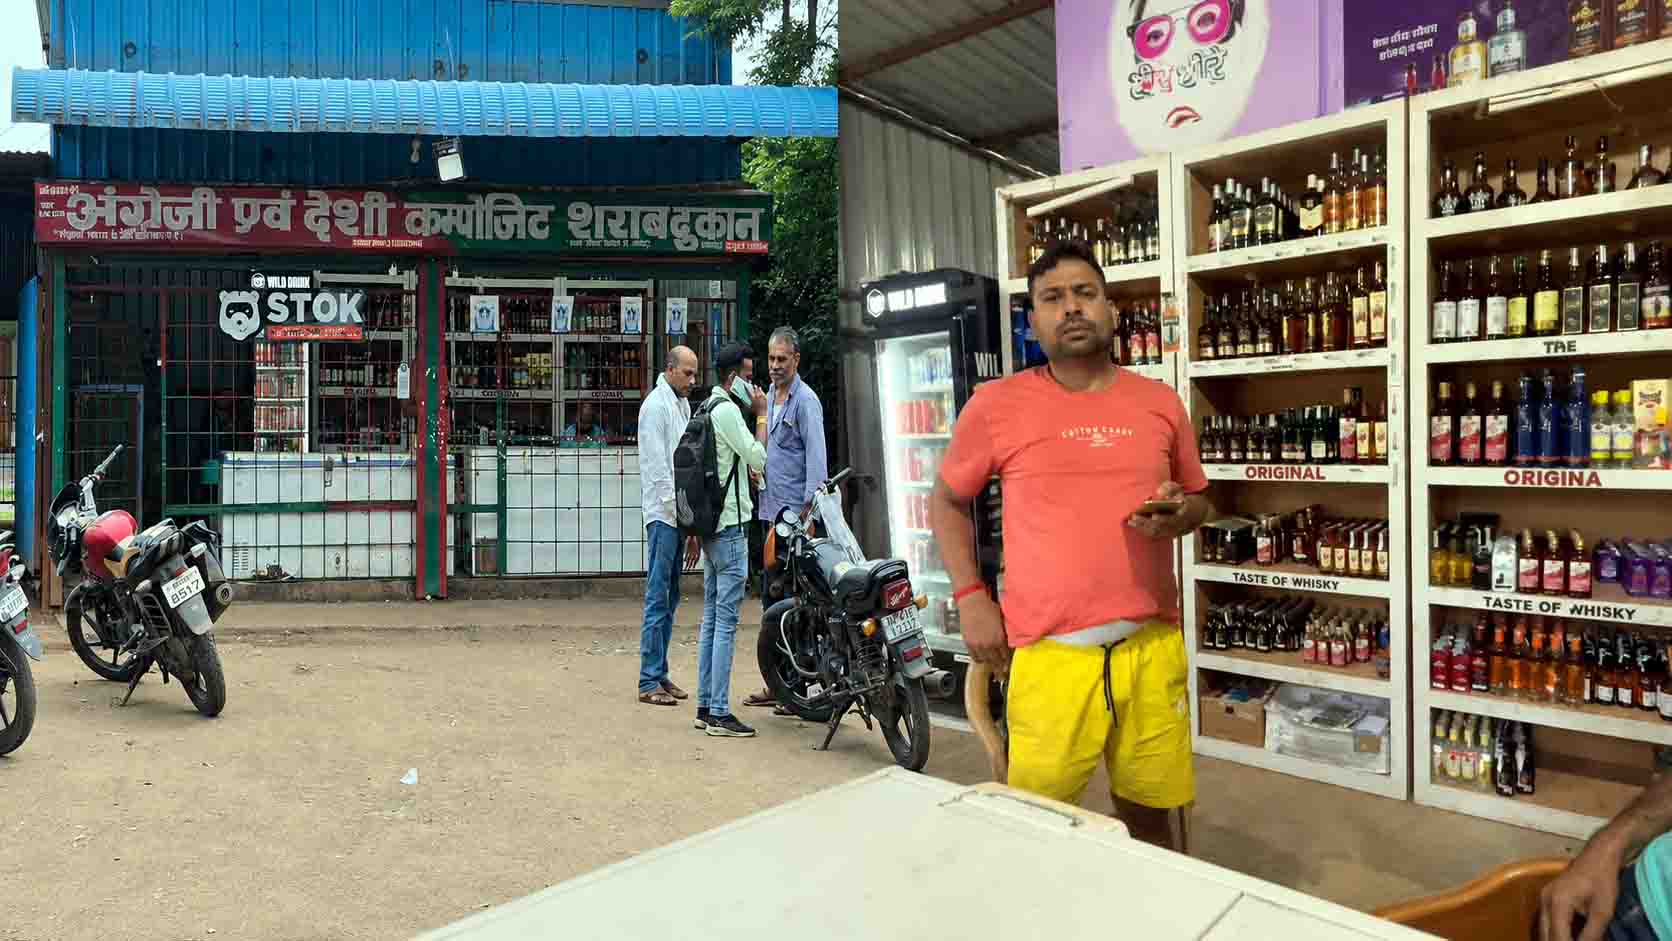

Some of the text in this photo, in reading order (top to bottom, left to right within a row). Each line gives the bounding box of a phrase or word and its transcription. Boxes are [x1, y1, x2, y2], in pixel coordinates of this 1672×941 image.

[267, 293, 362, 322] STOK
[1245, 466, 1326, 481] ORIGINAL
[1504, 470, 1602, 487] ORIGINA
[1232, 572, 1340, 591] TASTE OF WHISKY
[1483, 596, 1637, 621] TASTE OF WHISKY
